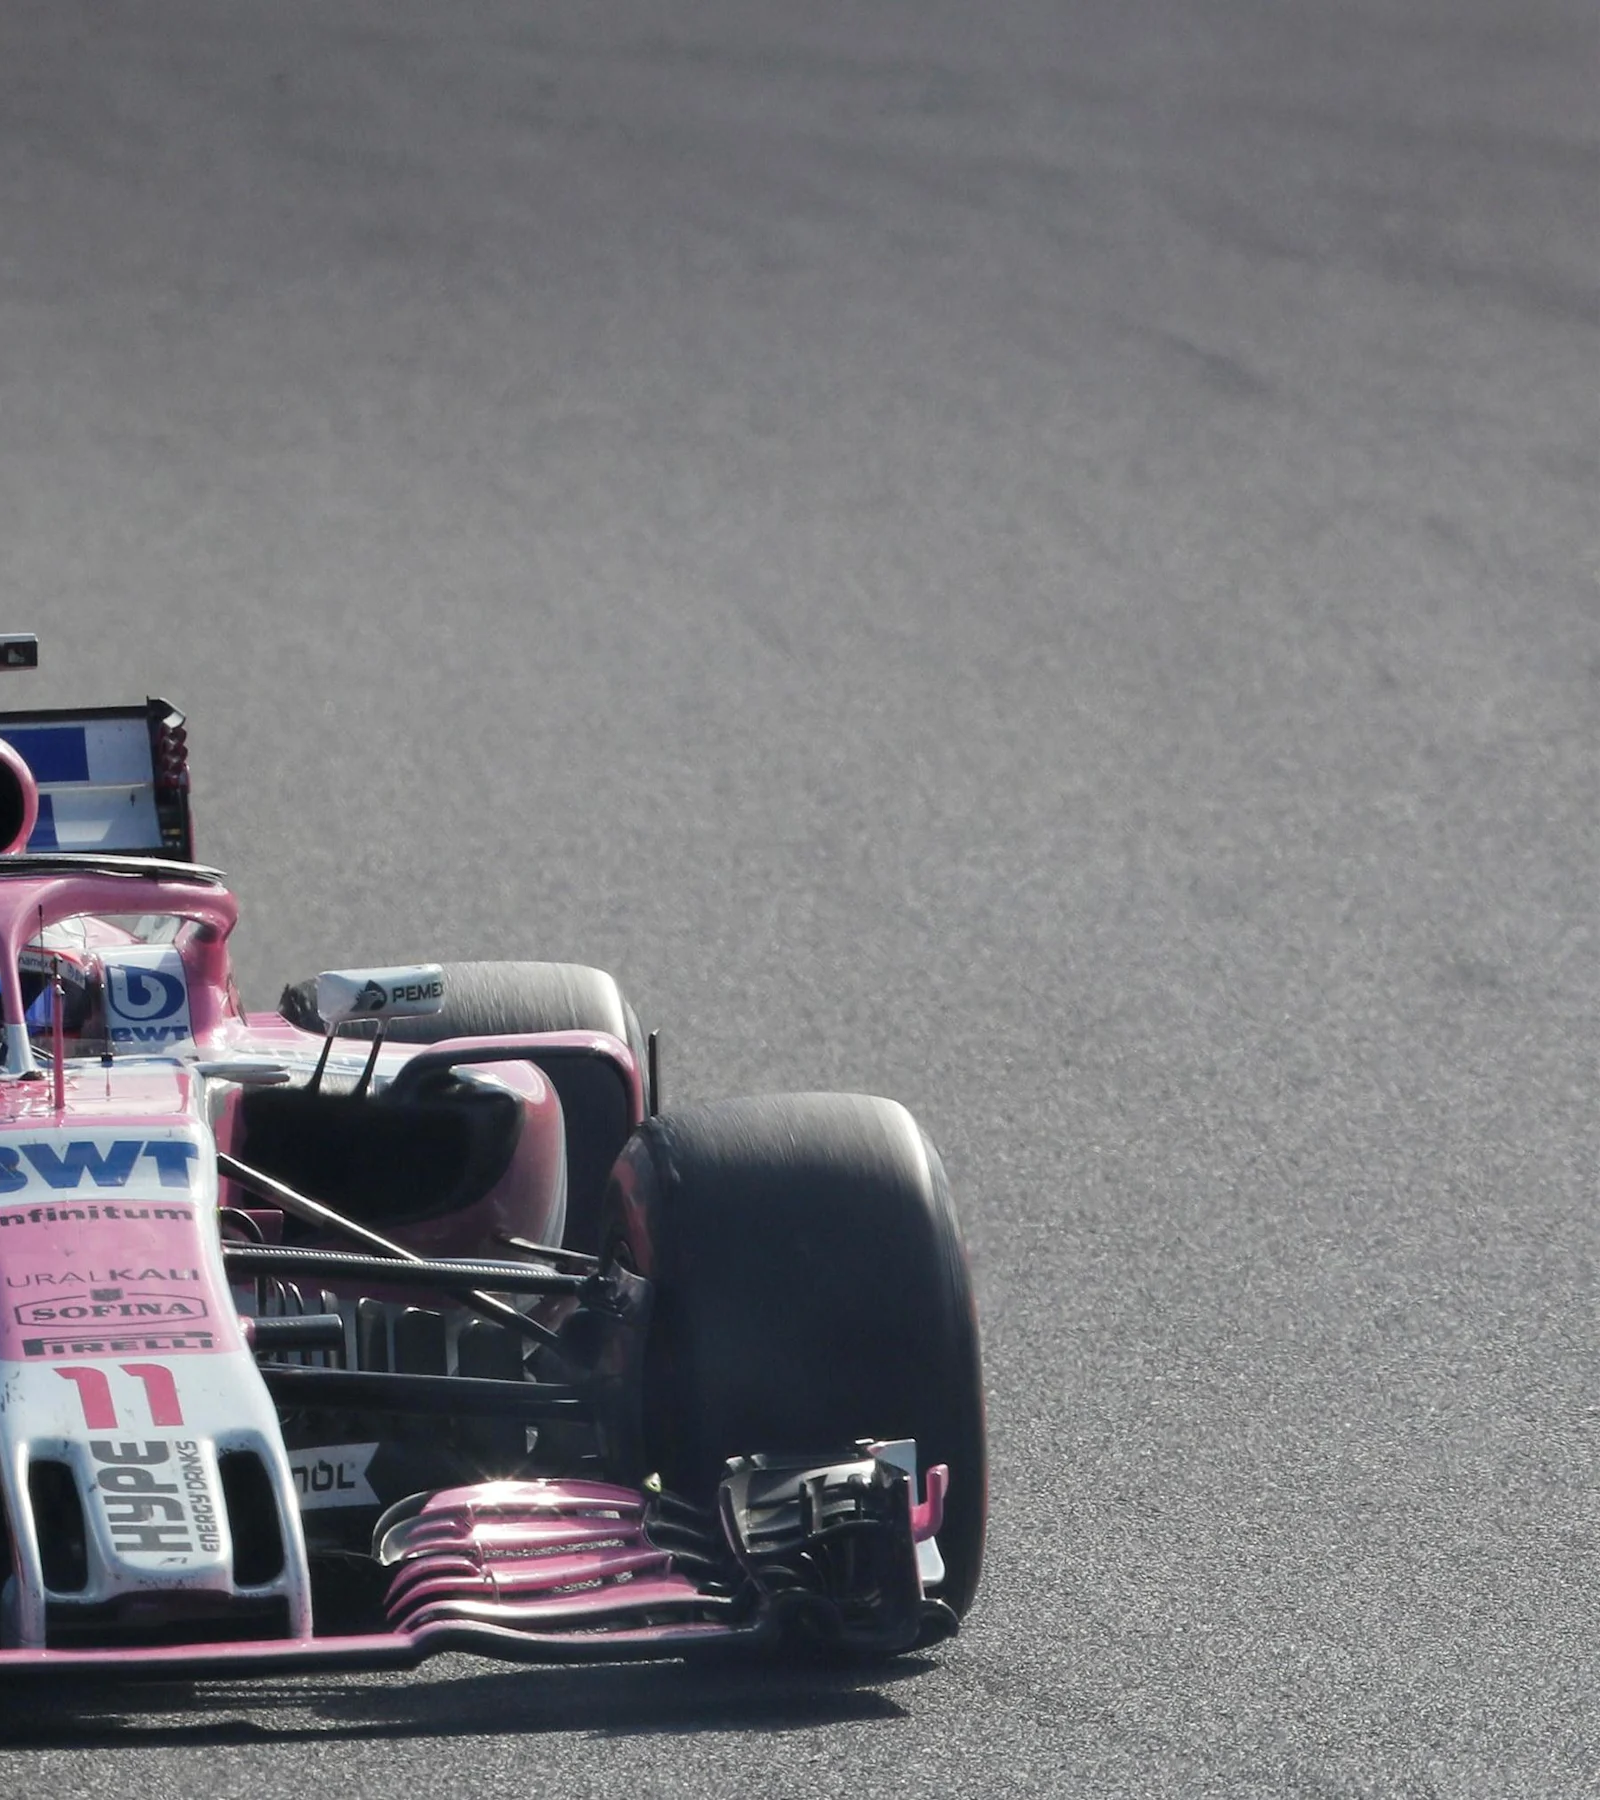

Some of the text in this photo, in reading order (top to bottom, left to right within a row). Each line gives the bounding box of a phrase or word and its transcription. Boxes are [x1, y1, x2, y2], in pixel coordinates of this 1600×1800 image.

[109, 1025, 188, 1043] BWT
[7, 1268, 200, 1288] URALKALI
[32, 1302, 195, 1322] SOFINA
[21, 1331, 215, 1357] PIRELLI
[52, 1363, 185, 1430] 11
[89, 1440, 194, 1552] HYPE
